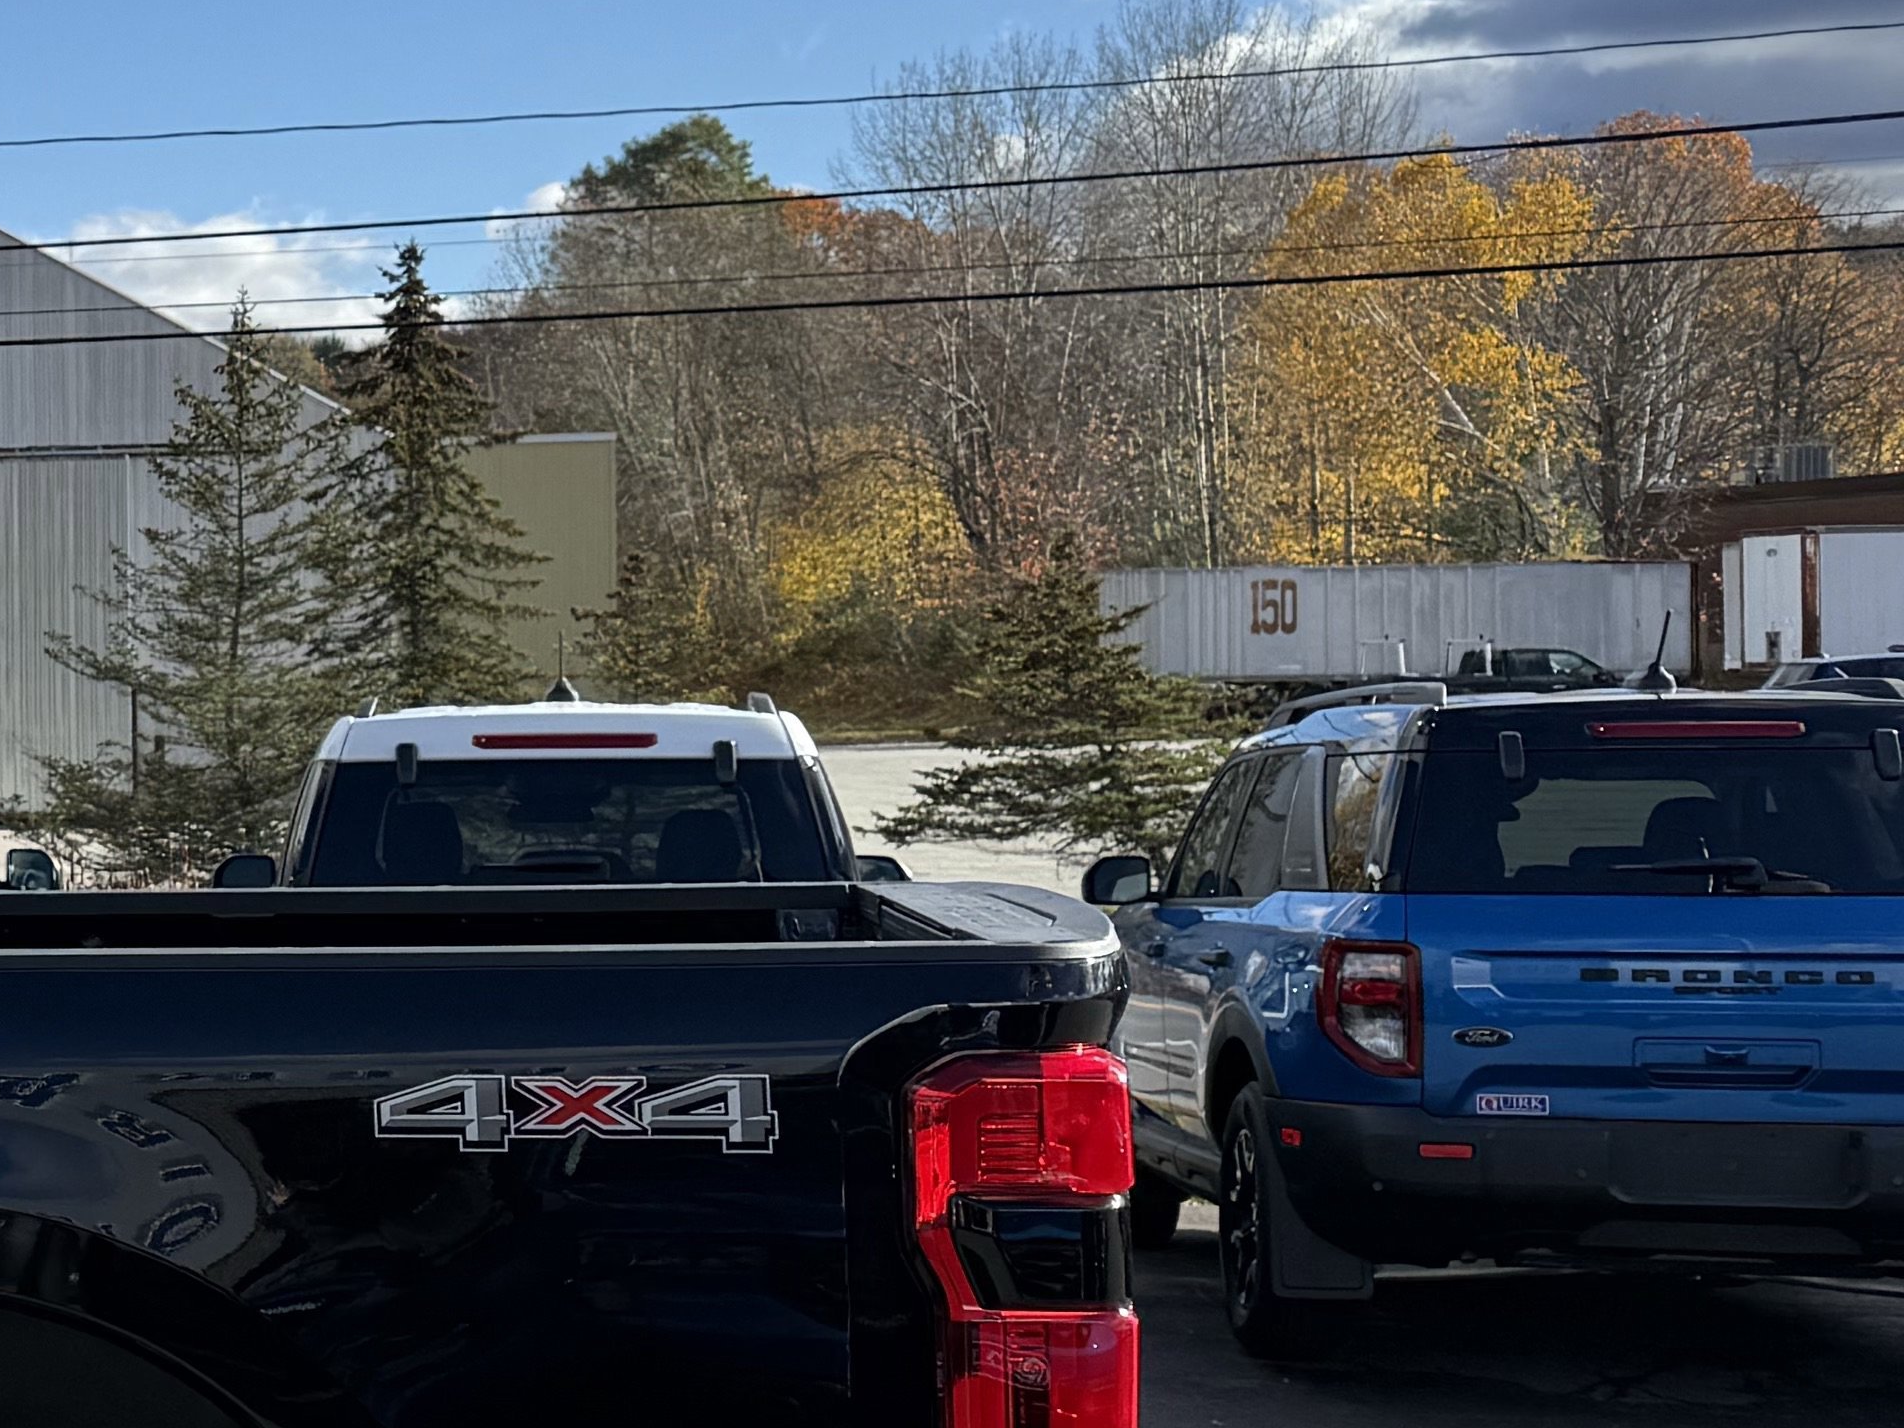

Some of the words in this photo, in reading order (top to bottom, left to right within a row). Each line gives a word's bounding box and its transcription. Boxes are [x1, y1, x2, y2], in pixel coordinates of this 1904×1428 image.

[1250, 578, 1298, 635] 150
[1579, 967, 1876, 985] BRONCO
[1481, 1095, 1543, 1111] QUIRK
